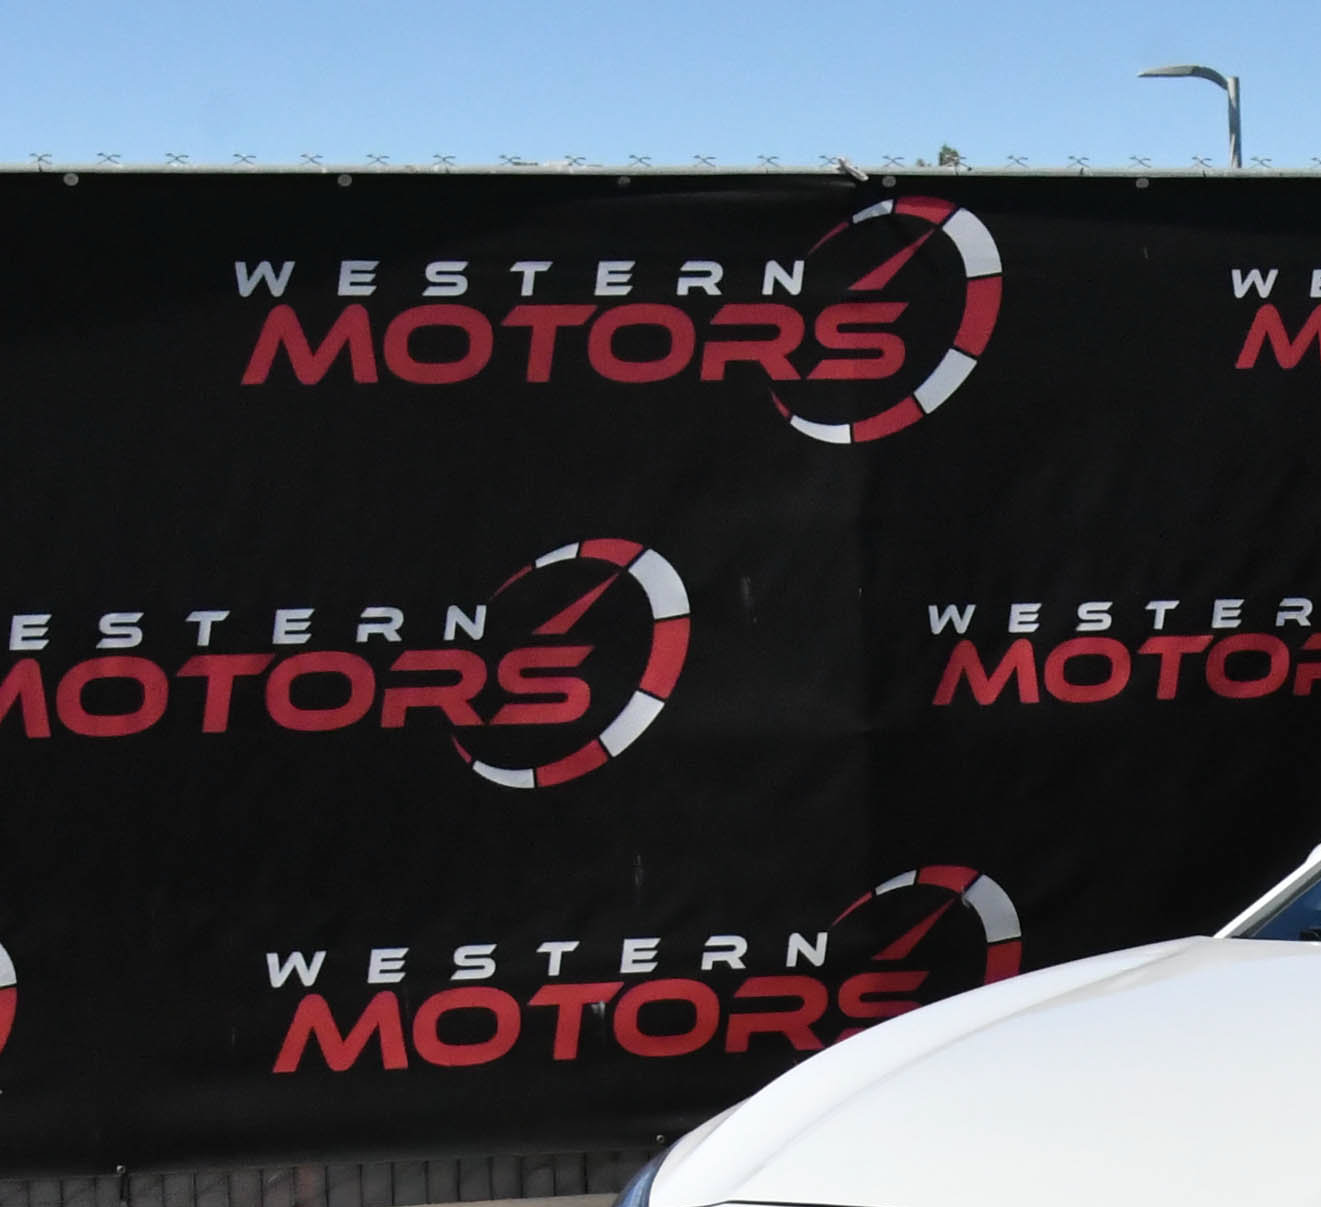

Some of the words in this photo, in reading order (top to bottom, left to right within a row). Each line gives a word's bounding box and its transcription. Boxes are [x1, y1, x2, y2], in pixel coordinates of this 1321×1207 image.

[236, 260, 805, 297] WESTERN
[242, 303, 908, 385] MOTORS
[9, 605, 487, 651] ESTERN
[266, 932, 828, 988] WESTERN
[272, 971, 930, 1073] MOTORS
